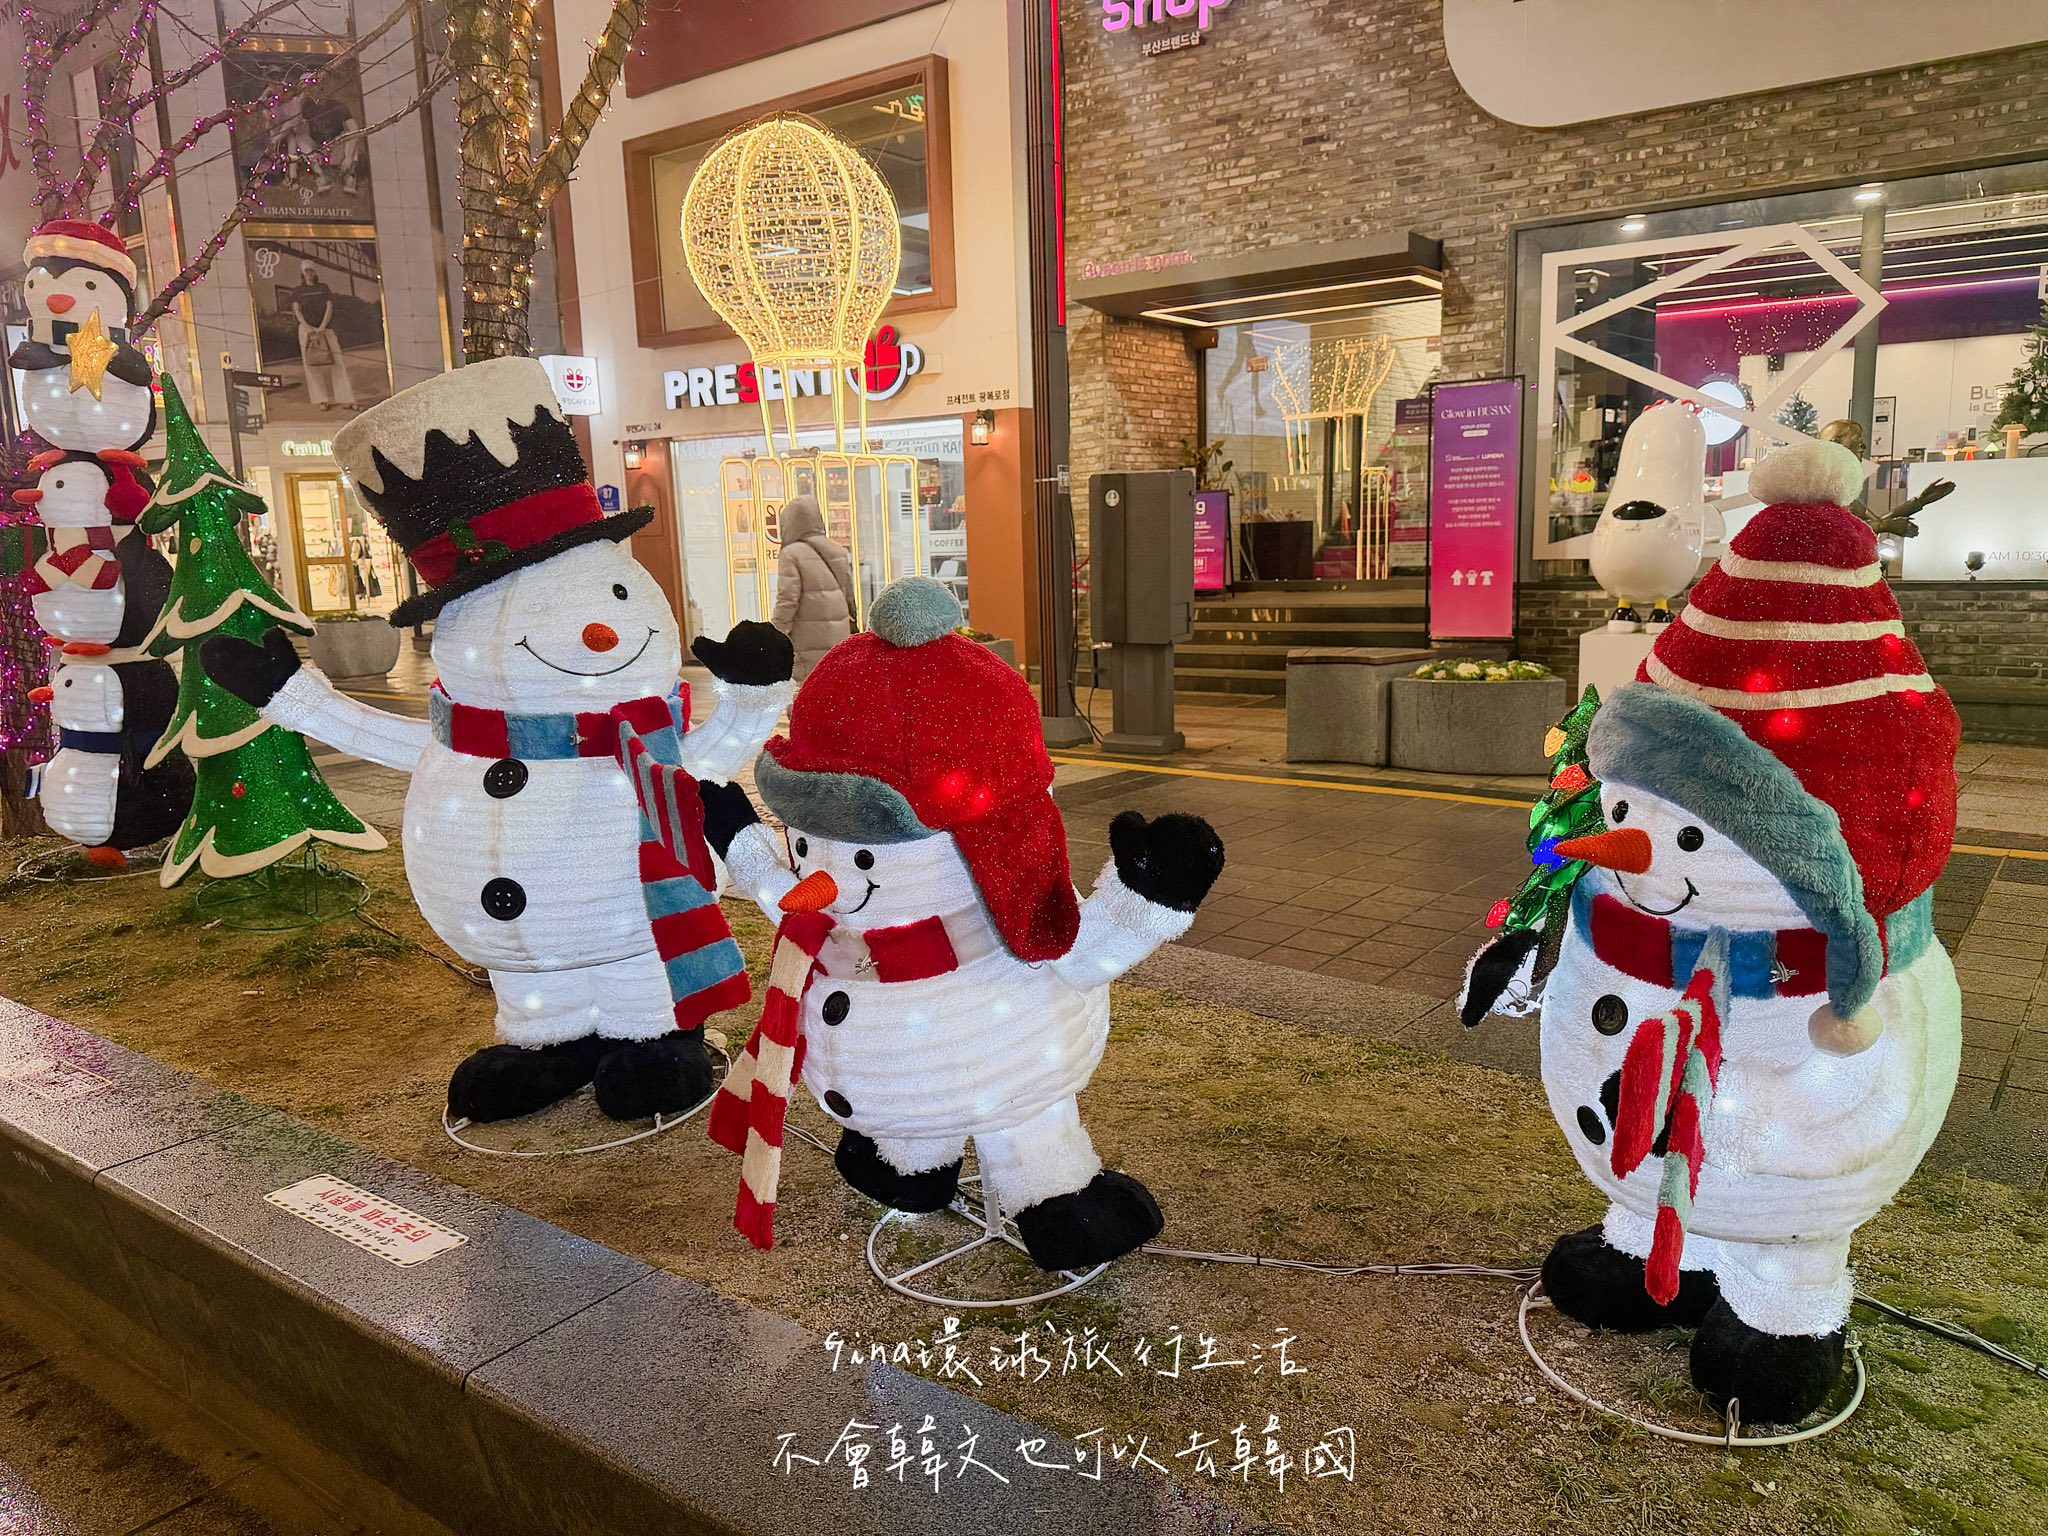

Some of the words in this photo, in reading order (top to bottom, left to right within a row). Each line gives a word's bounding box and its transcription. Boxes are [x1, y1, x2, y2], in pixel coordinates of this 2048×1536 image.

[264, 206, 296, 216] GRAIN
[298, 207, 313, 216] DE
[314, 207, 353, 217] BEAUTE
[1440, 408, 1466, 420] Glow
[602, 487, 613, 500] 87
[1988, 551, 2010, 561] AM
[314, 1189, 369, 1213] 시설물
[360, 1208, 433, 1243] 파손주의
